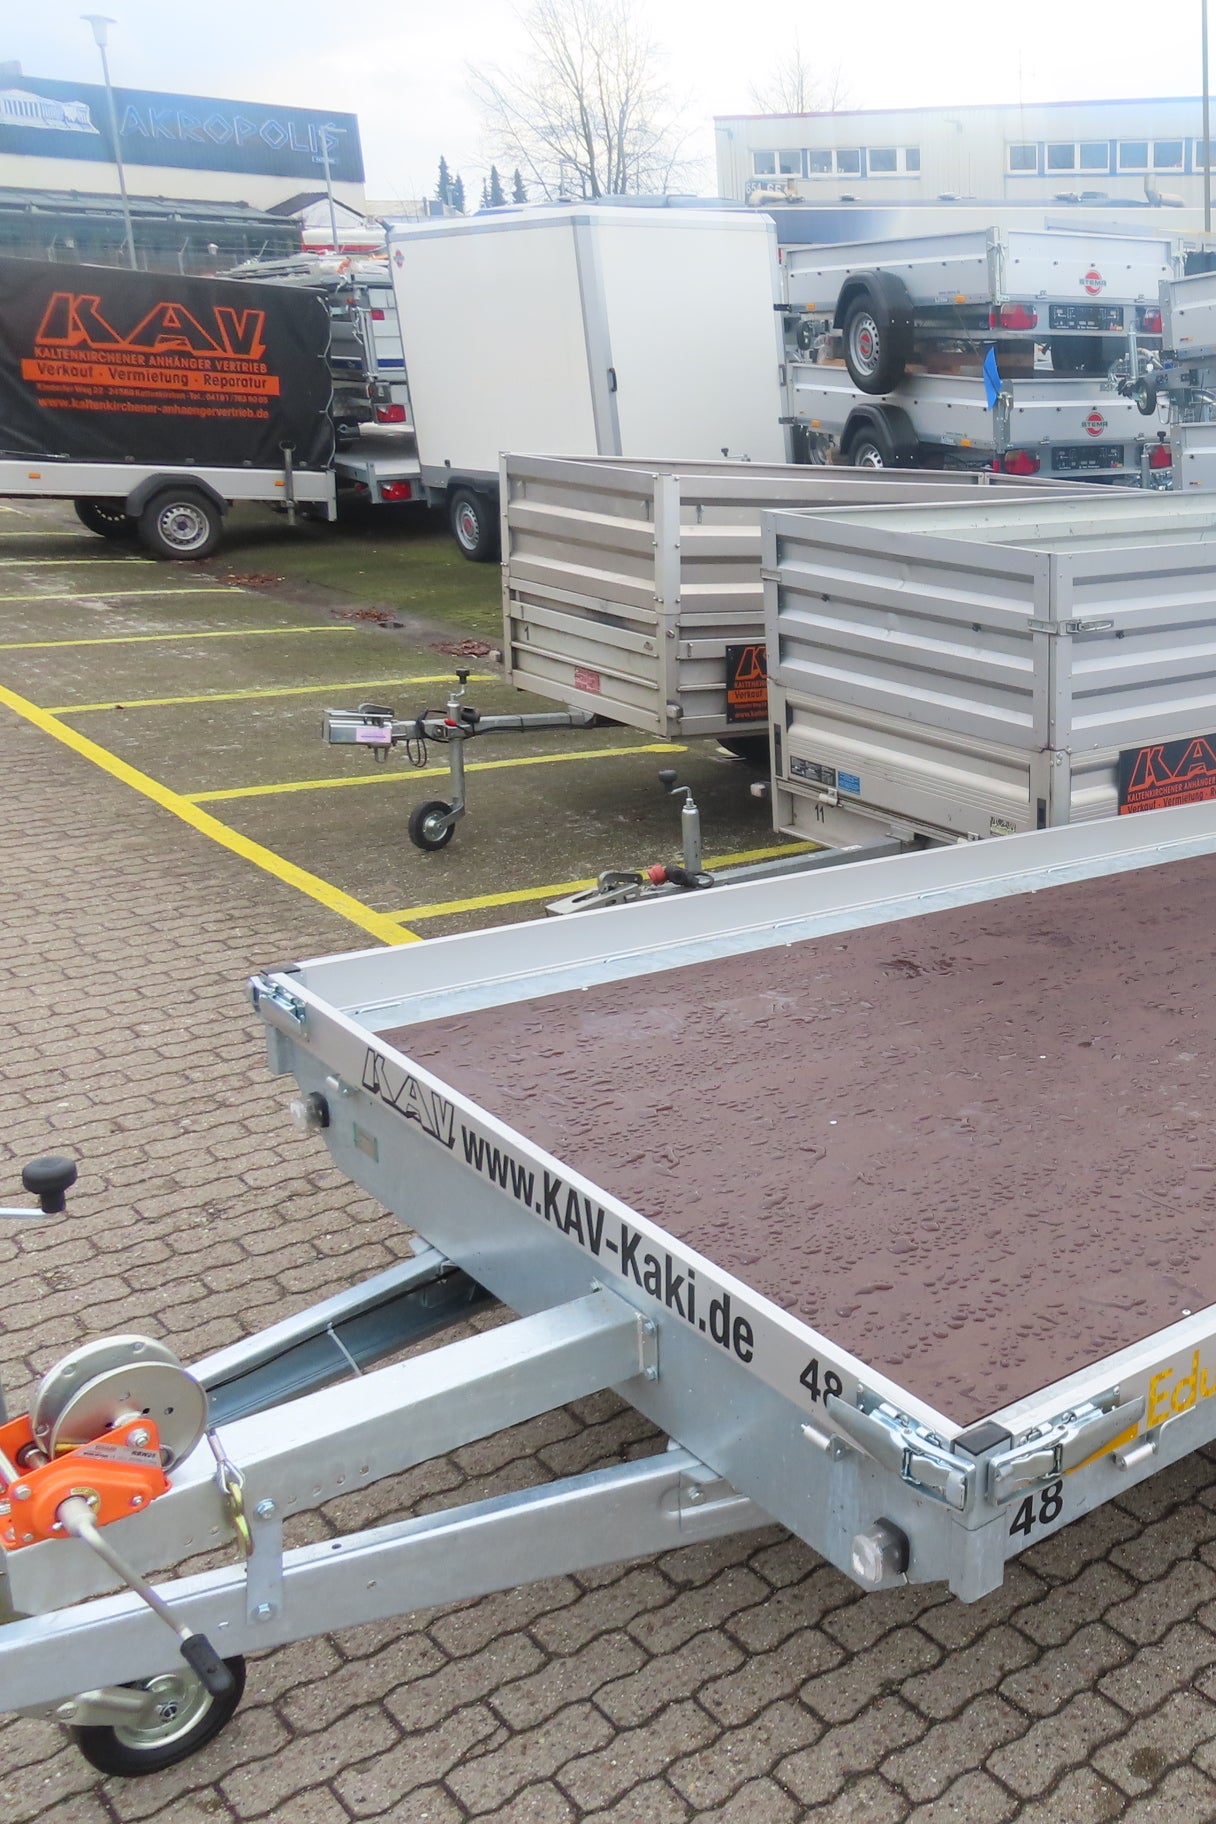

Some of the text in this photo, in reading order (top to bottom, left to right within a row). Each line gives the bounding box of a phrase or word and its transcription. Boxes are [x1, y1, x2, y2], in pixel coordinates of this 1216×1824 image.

[119, 104, 340, 153] AKROPOLIS
[35, 292, 267, 360] KAV
[37, 362, 267, 389] Verkauf Vermietung Reparatur
[215, 361, 268, 374] VERTRIEB
[1127, 784, 1184, 803] KALTENKIRCHENER
[1163, 791, 1204, 807] Vermietung
[814, 804, 825, 823] 11
[361, 1047, 844, 1405] KAV www.KAV-Kaki.de 48
[1008, 1480, 1064, 1537] 48
